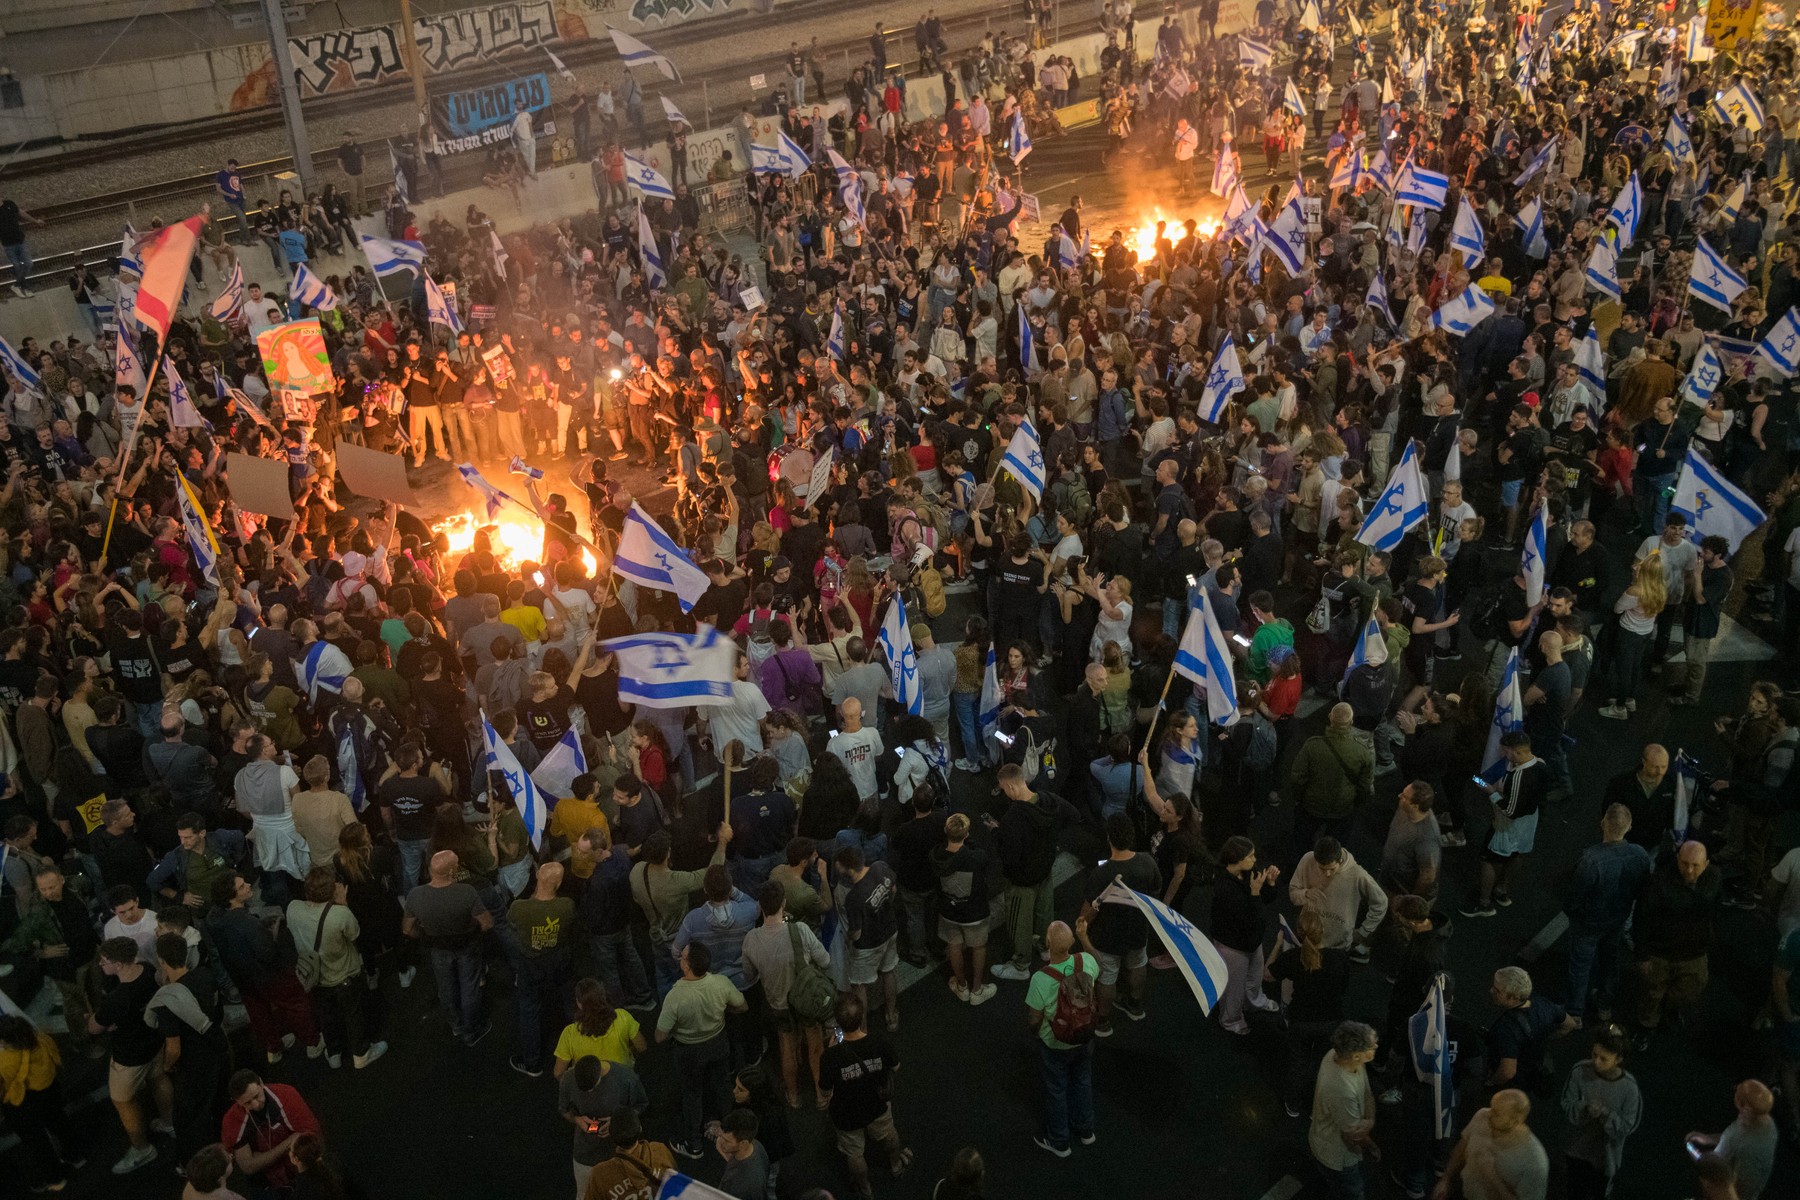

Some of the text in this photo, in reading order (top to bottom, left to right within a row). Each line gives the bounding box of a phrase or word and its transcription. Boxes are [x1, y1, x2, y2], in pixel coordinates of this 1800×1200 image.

[1718, 9, 1746, 20] EXIT
[412, 2, 561, 72] הפועל
[844, 744, 871, 759] בחירות
[608, 1167, 661, 1200] JORN
